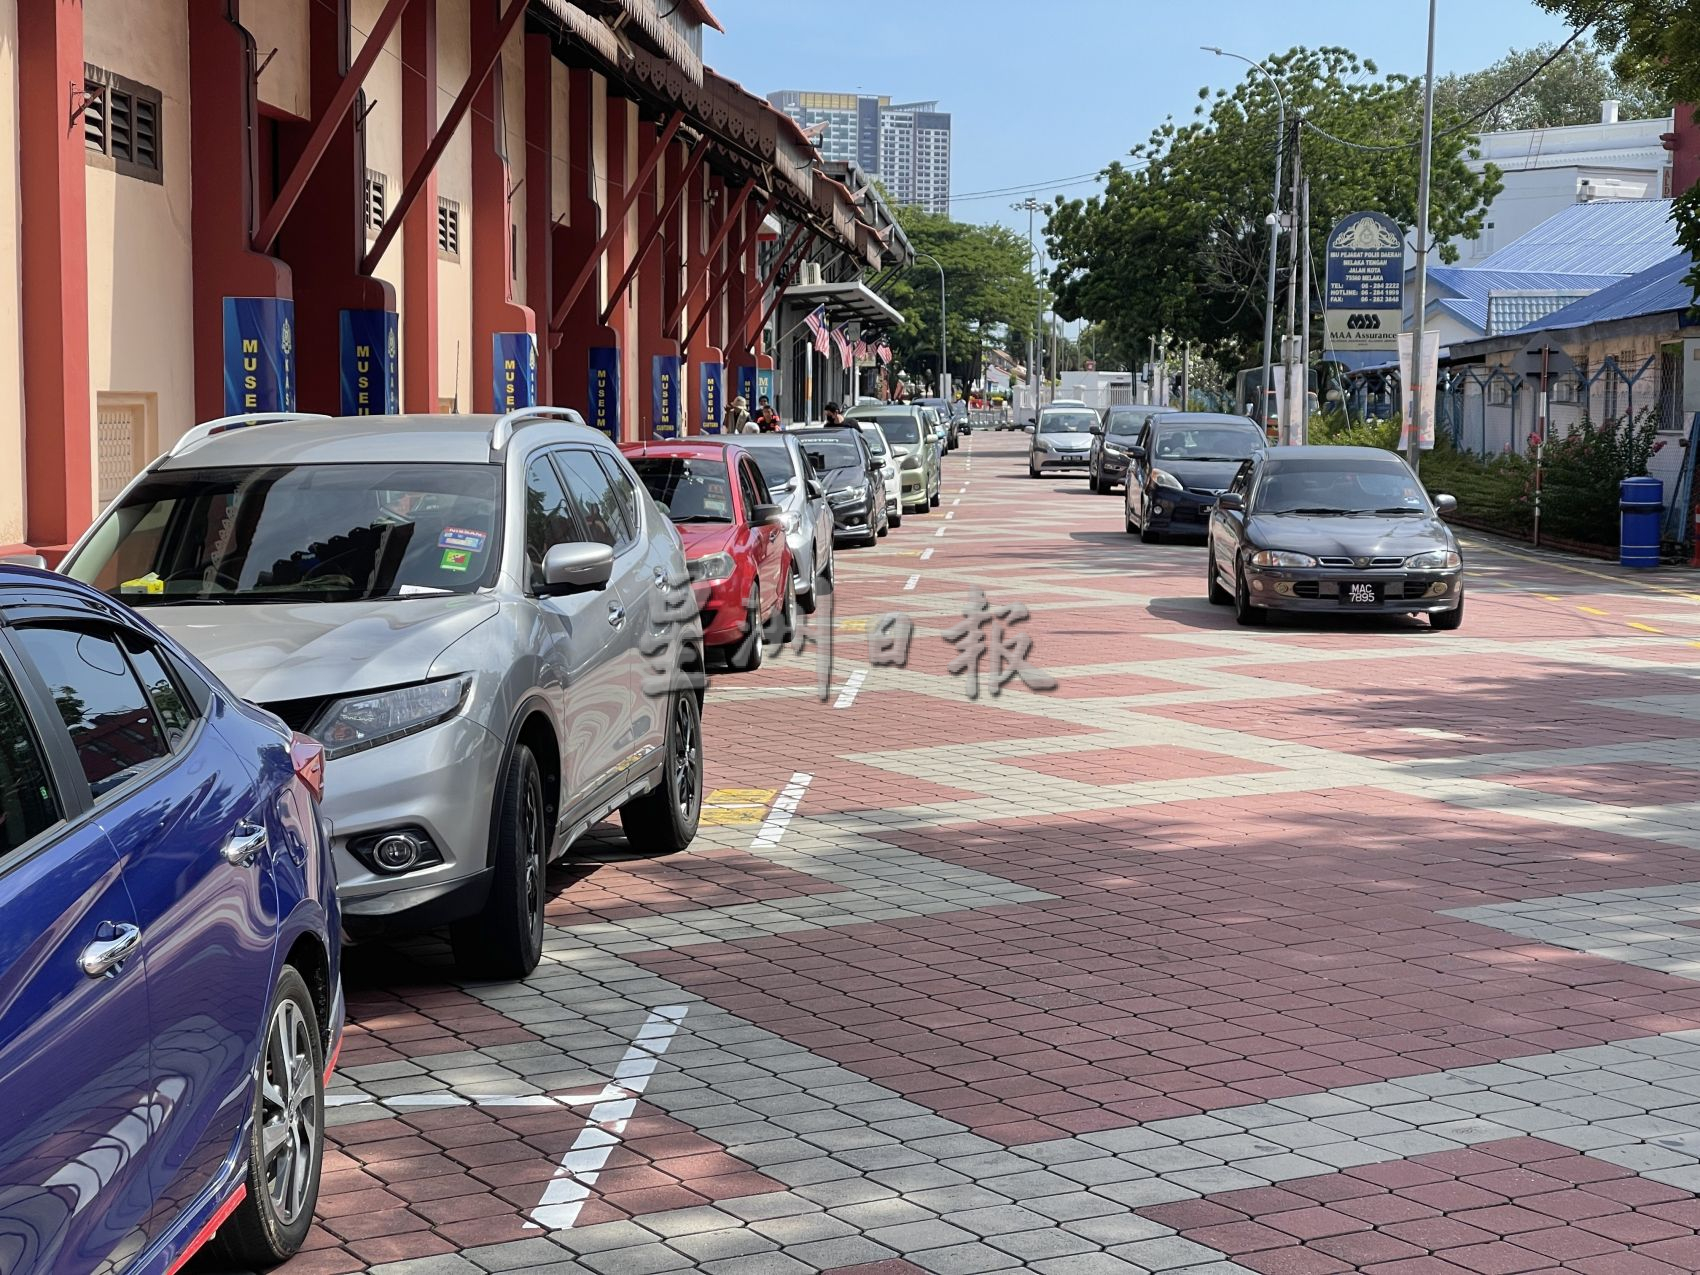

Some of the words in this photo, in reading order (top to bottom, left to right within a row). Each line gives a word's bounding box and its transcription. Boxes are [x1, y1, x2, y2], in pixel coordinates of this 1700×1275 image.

[1330, 331, 1352, 339] MAA
[1355, 331, 1398, 339] Assurance
[597, 369, 607, 427] MUSEUM
[661, 374, 669, 423] MUSEUM
[1351, 583, 1373, 593] MAC
[1348, 592, 1375, 602] 7895
